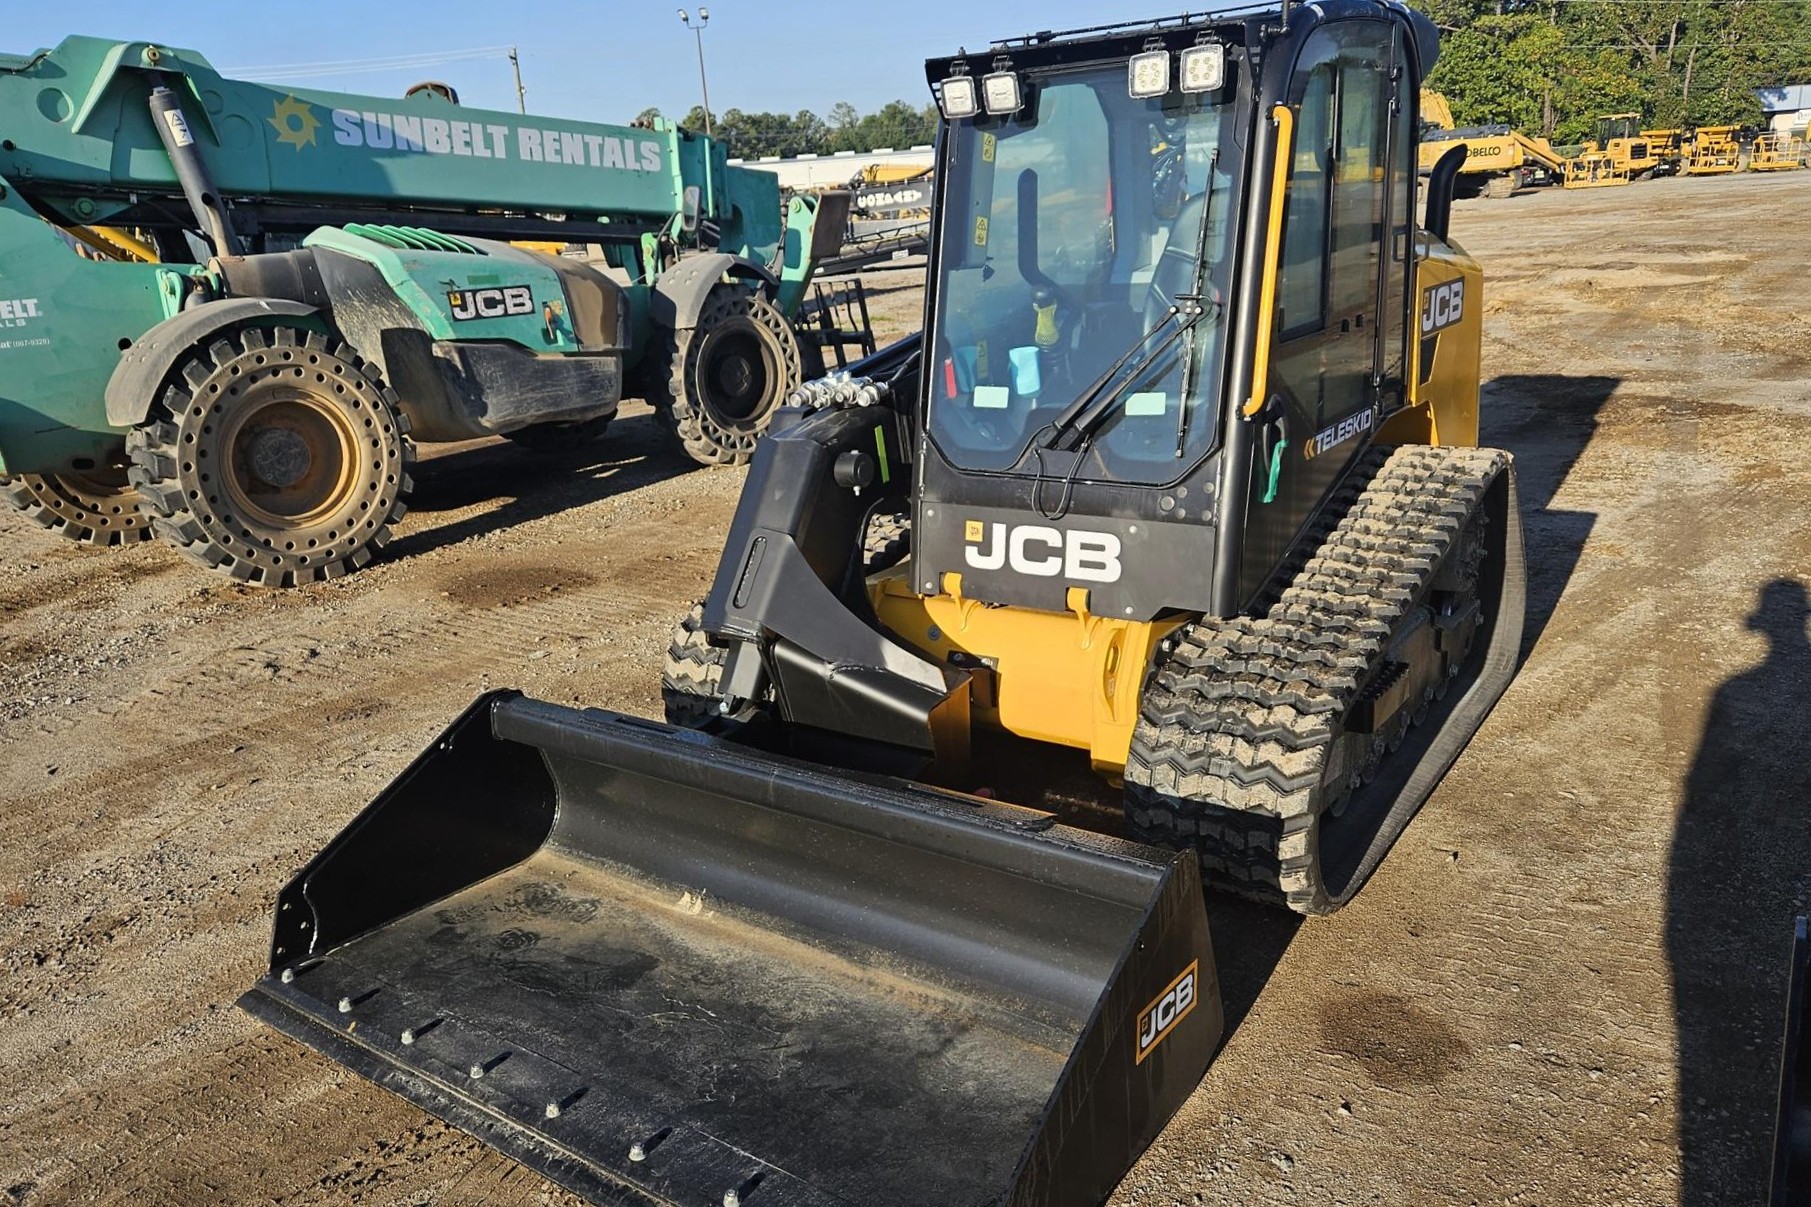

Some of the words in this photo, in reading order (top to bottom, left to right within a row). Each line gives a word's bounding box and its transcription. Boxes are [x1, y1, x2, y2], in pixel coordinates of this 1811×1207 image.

[332, 109, 509, 159] SUNBELT
[517, 127, 661, 172] RENTALS
[1466, 146, 1501, 158] OBELCO
[452, 287, 534, 320] JCB
[1423, 281, 1464, 332] JCB
[1315, 408, 1372, 455] TELESKID
[964, 522, 1122, 583] JCB
[1141, 973, 1194, 1048] JCB
